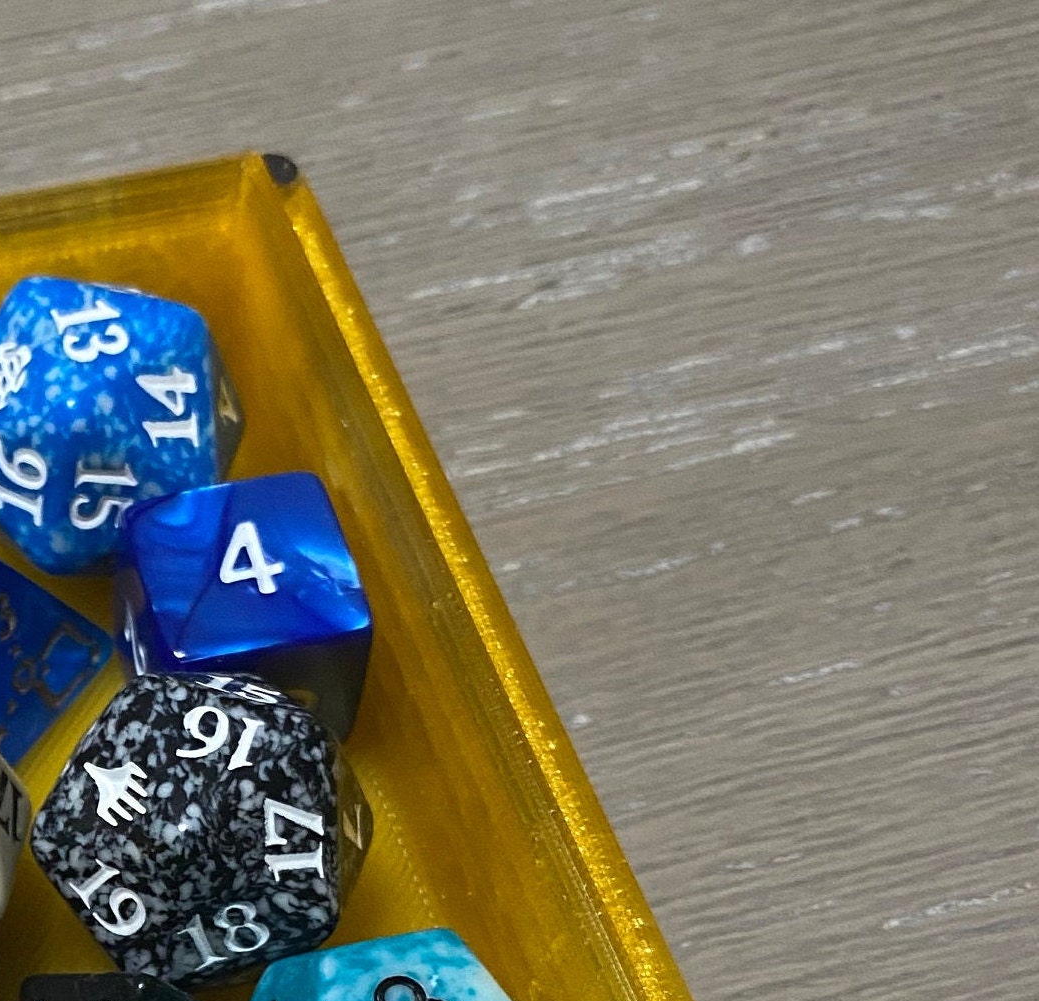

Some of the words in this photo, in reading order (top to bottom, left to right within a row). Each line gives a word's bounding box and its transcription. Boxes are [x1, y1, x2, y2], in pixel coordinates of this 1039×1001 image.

[50, 300, 129, 363] 13
[135, 366, 199, 448] 14
[68, 460, 139, 530] 15
[220, 521, 286, 594] 4
[175, 705, 265, 771] 16
[264, 798, 325, 882] 17
[69, 858, 147, 937] 19
[176, 901, 270, 972] 18
